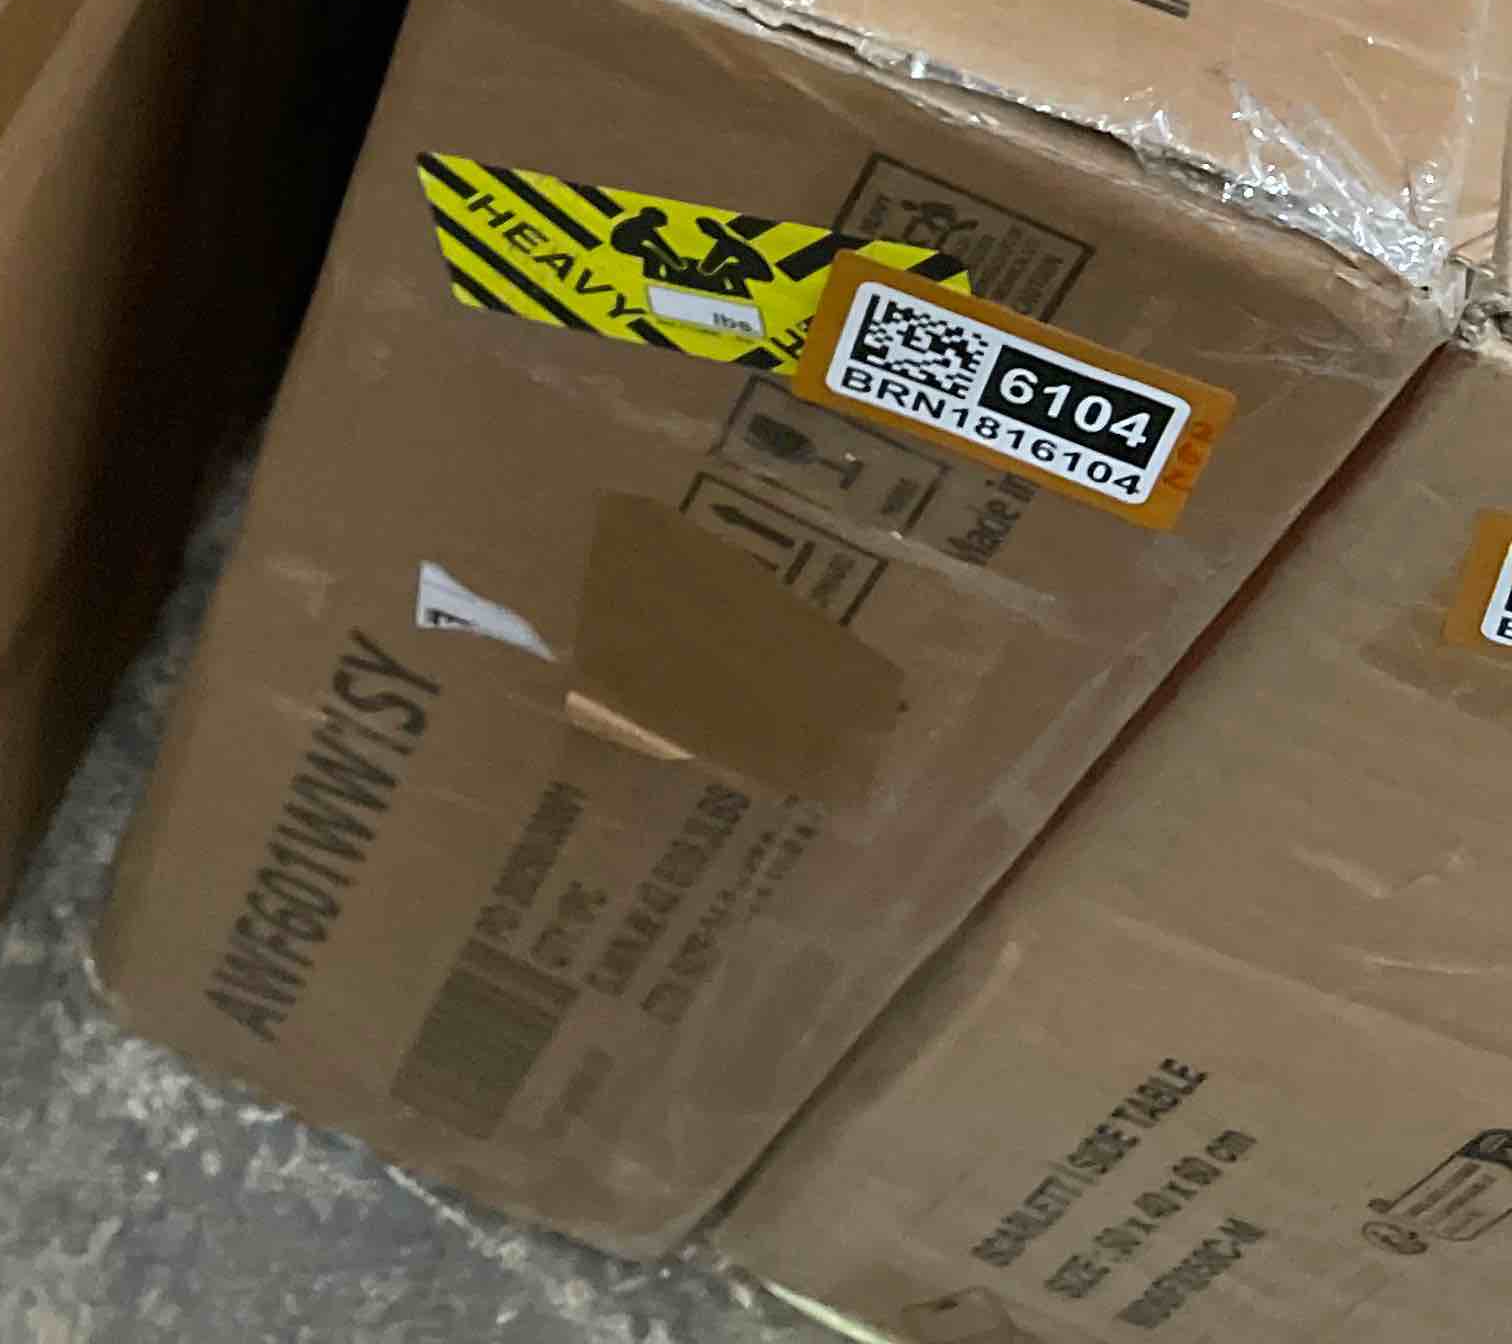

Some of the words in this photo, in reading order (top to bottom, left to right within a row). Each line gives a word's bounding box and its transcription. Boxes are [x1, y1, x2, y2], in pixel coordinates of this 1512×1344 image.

[467, 192, 646, 319] HEAVY
[713, 312, 753, 333] lbs
[840, 365, 1142, 496] BRN1816104
[999, 367, 1150, 449] 6104
[1110, 1058, 1208, 1129] TABLE
